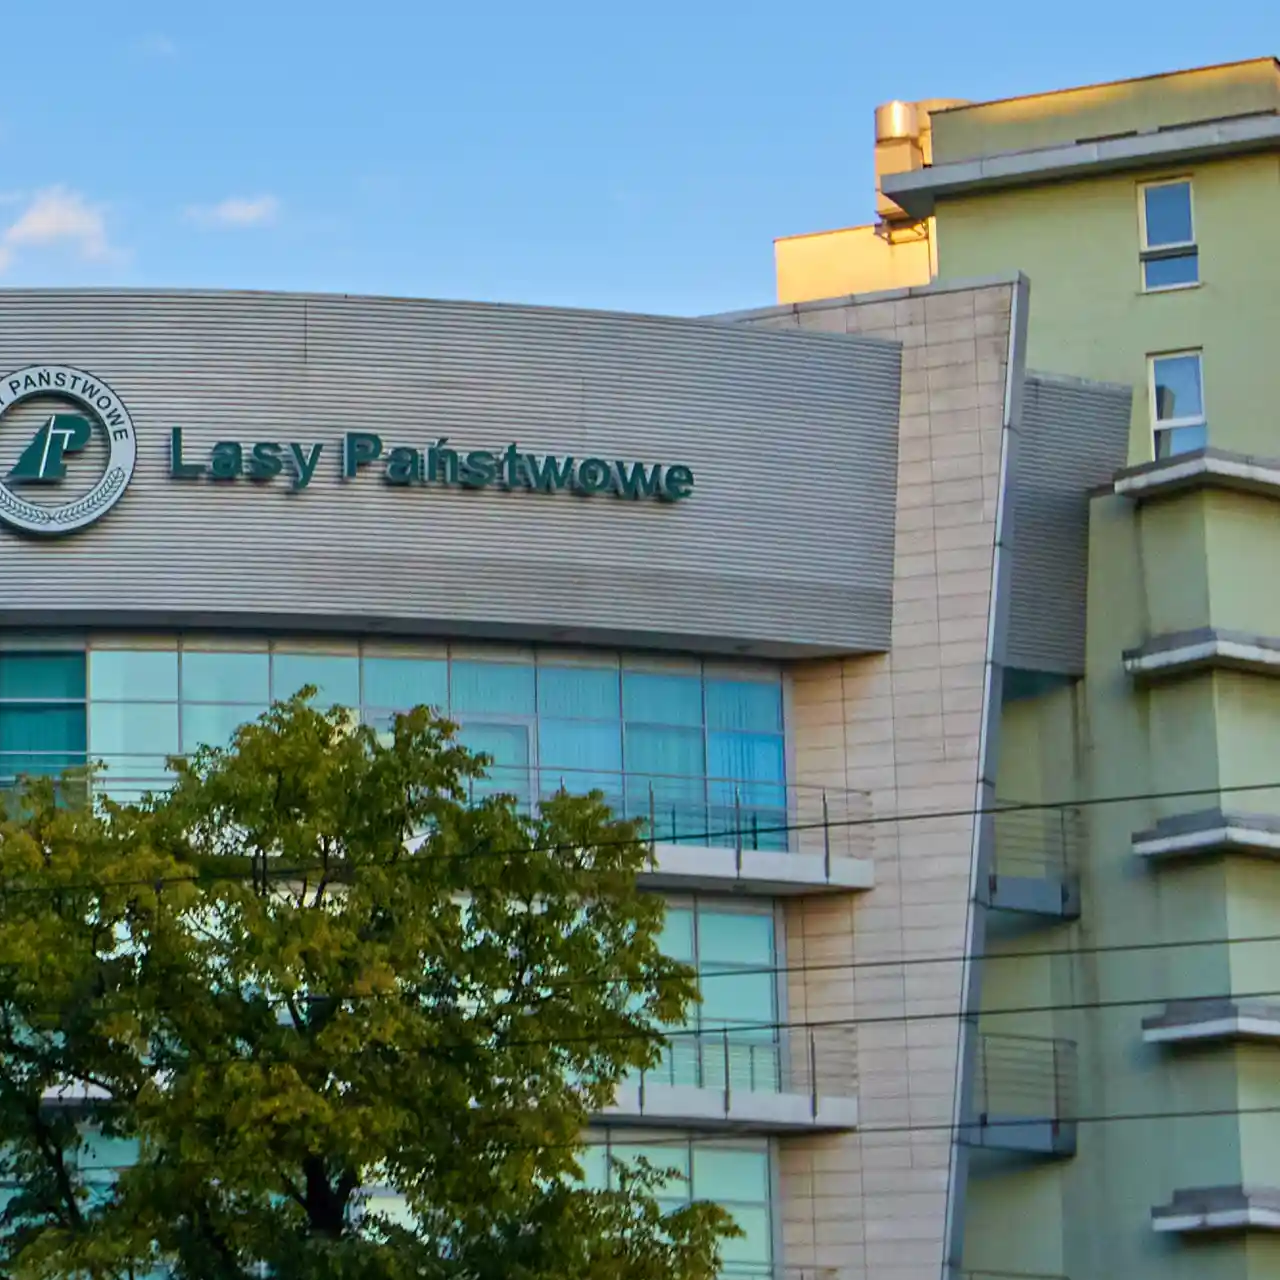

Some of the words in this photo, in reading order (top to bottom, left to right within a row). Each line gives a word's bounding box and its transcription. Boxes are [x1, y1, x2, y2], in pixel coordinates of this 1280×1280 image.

[8, 368, 129, 443] PAŃSTWOWE
[170, 425, 324, 492] Lasy
[342, 430, 696, 503] Państwowe
